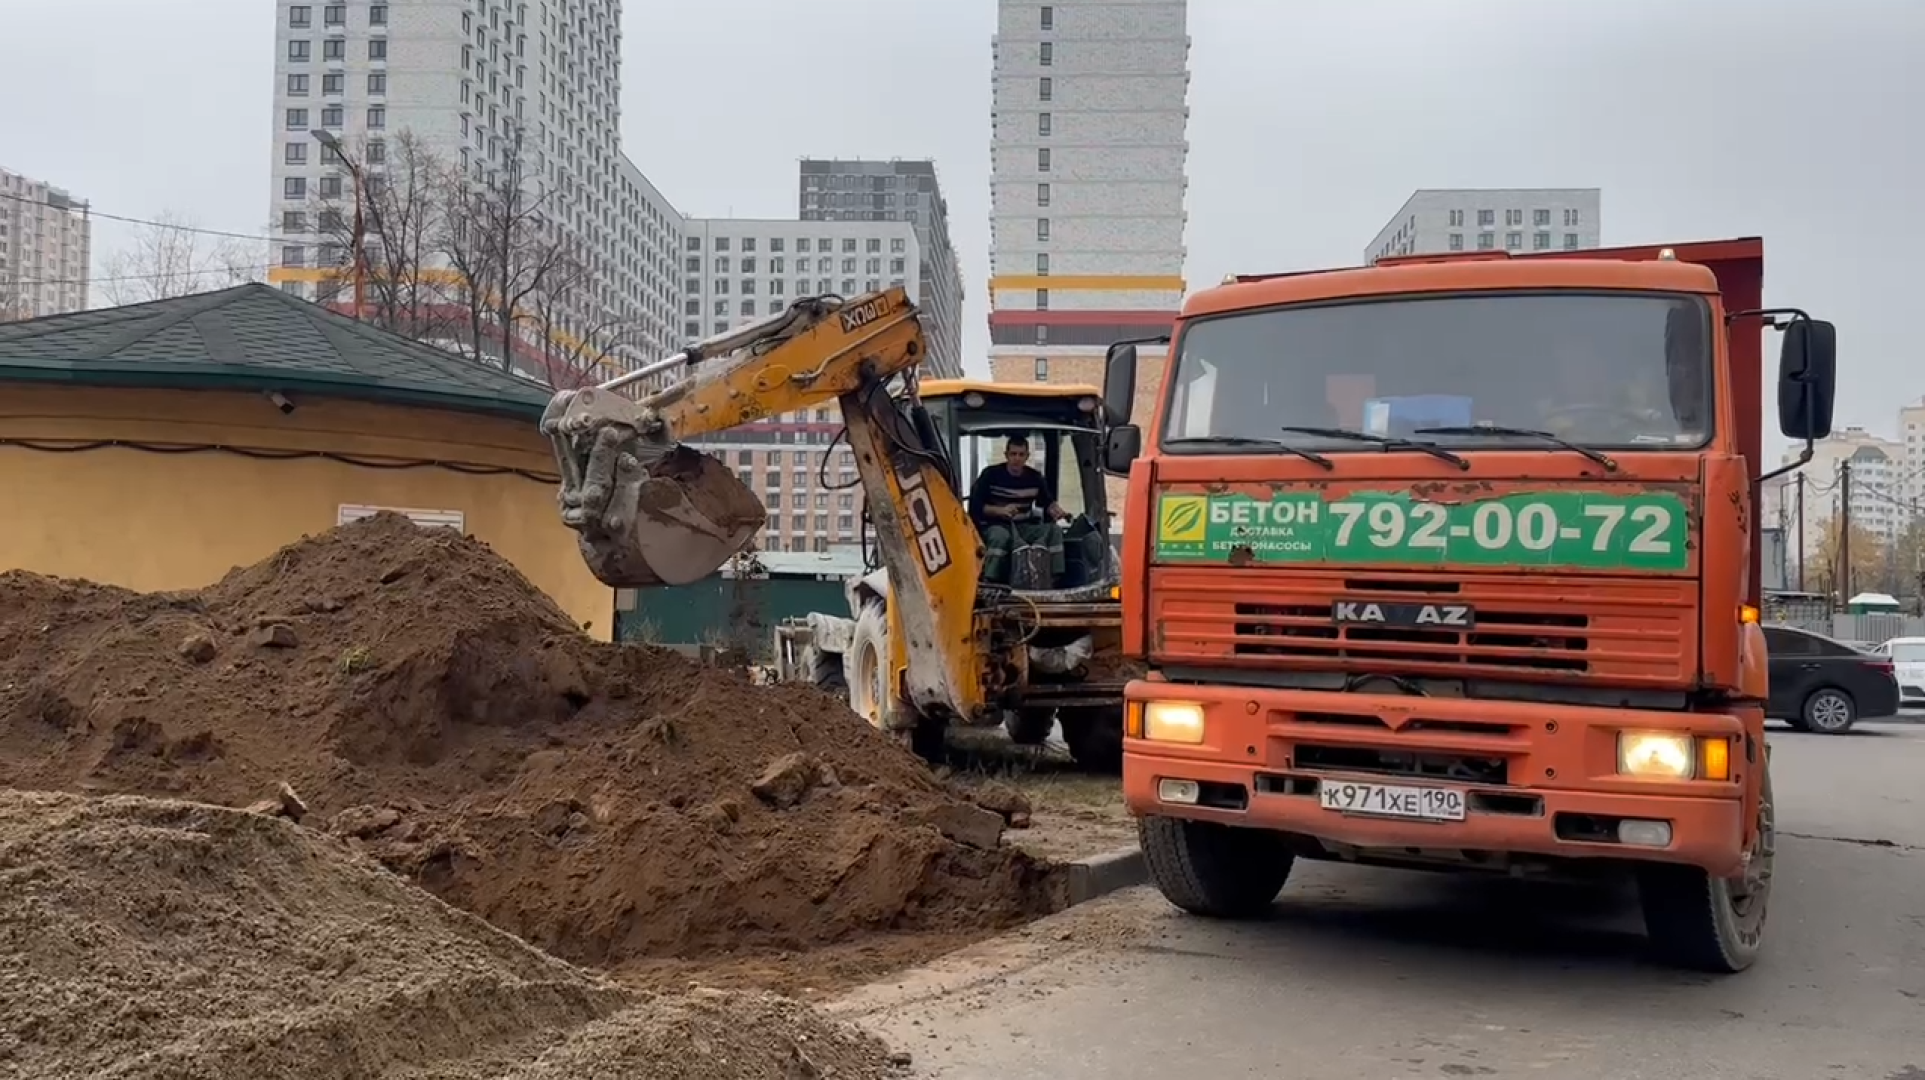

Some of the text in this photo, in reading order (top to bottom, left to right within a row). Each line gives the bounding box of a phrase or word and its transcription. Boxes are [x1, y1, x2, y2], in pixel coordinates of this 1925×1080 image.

[895, 468, 948, 573] JCB
[1210, 501, 1319, 523] БЕТОН
[1328, 502, 1671, 553] 792-00-72
[1328, 785, 1457, 813] К971ХЕ 190
